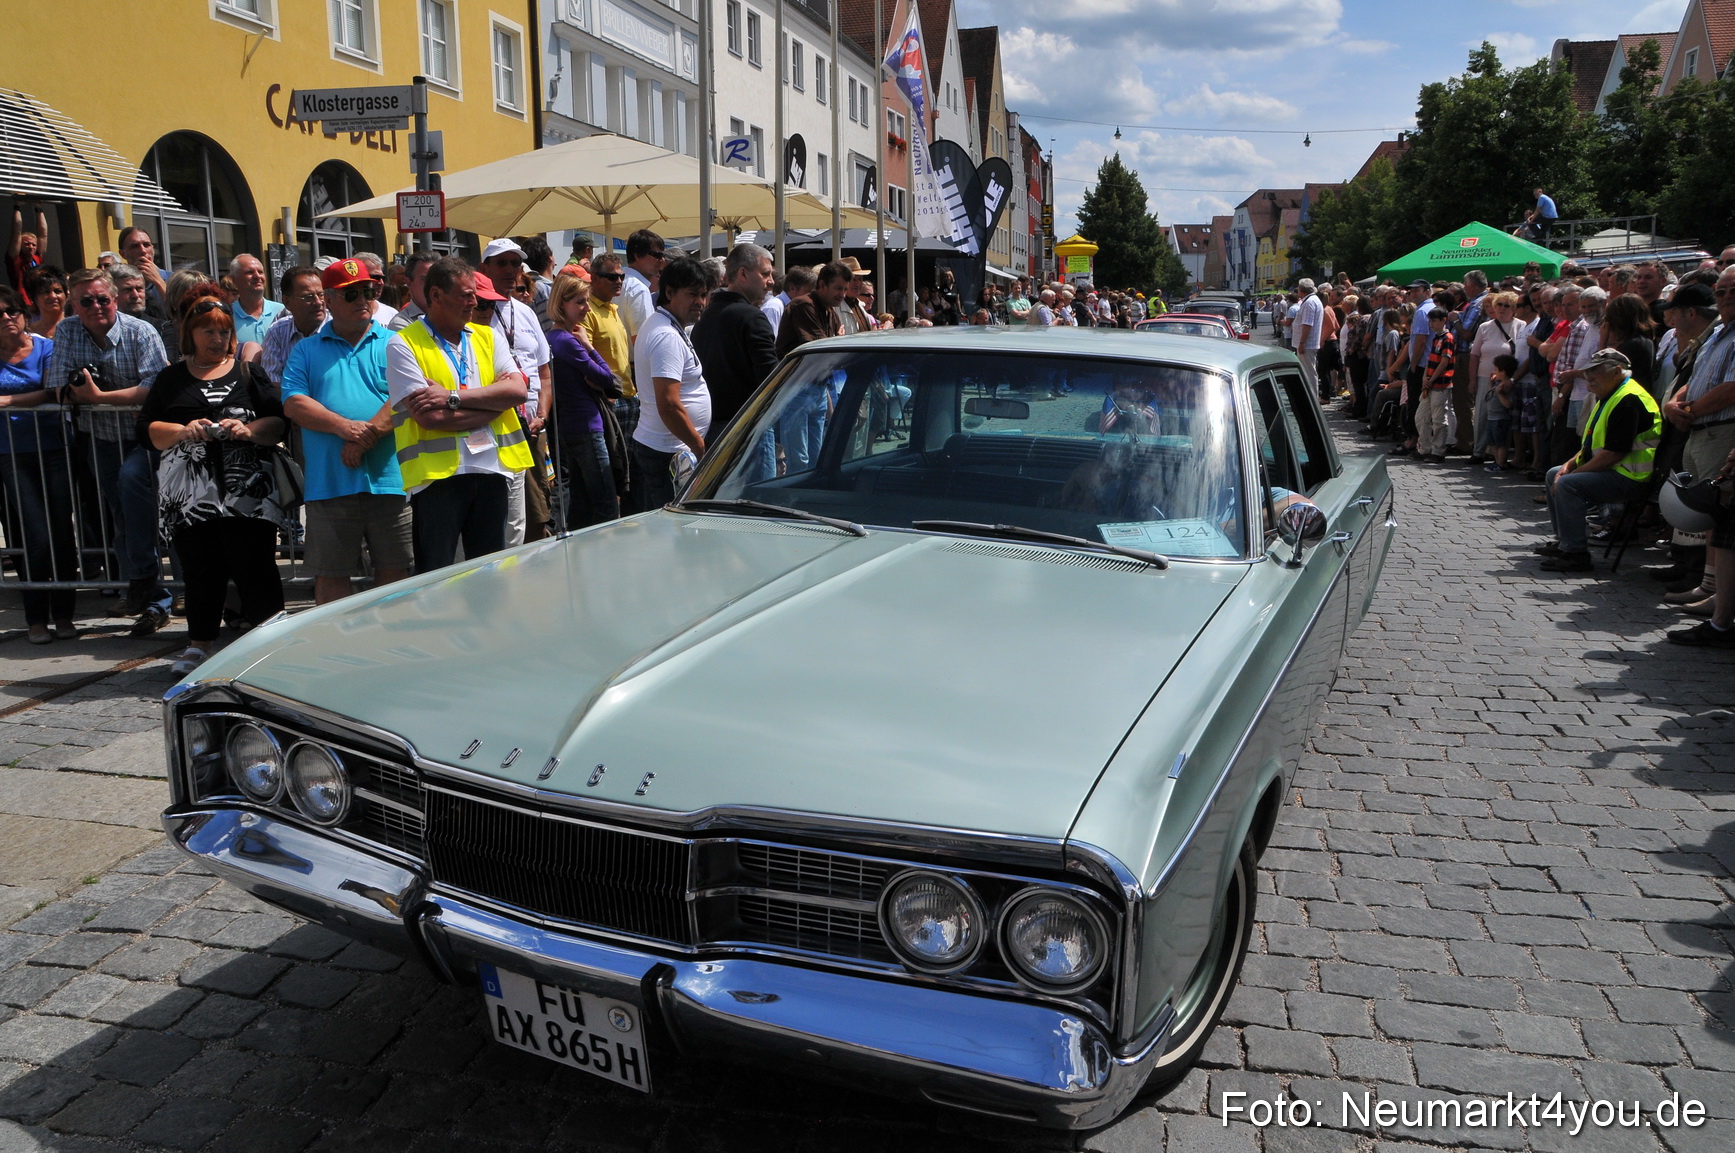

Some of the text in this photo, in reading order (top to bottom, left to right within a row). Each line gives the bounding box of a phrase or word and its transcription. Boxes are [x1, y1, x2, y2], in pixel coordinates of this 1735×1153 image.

[603, 6, 669, 57] BRILLEN WEBER
[302, 94, 399, 115] Klostergasse
[402, 195, 432, 206] H 200
[1042, 205, 1053, 259] HOTEL
[1429, 251, 1501, 260] Lammsbräu
[1441, 247, 1493, 255] Neumarkter
[1164, 526, 1210, 539] 124
[459, 738, 657, 796] DODGE
[486, 980, 496, 992] D
[535, 980, 586, 1027] FÜ
[496, 1004, 643, 1086] AX 865H
